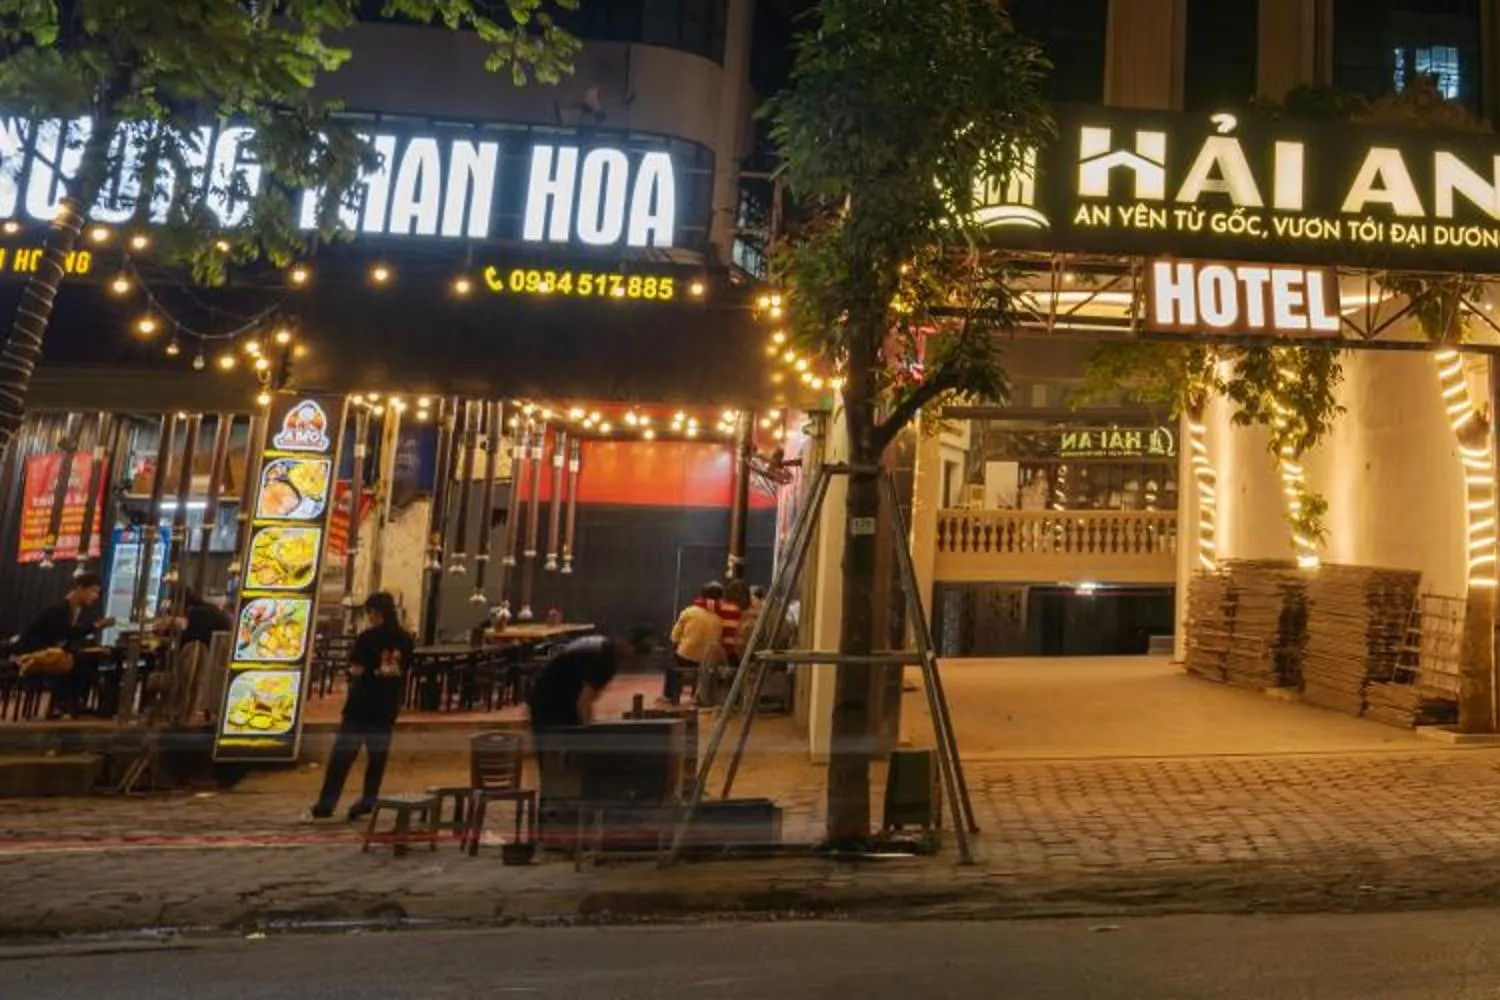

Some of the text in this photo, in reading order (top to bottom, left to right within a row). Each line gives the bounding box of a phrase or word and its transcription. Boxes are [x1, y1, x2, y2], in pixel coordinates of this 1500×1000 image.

[523, 144, 676, 248] HOA
[1078, 113, 1304, 211] HẢI
[1074, 204, 1111, 226] AN
[1118, 203, 1167, 229] YÊN
[1174, 207, 1207, 231] TỪ
[1273, 216, 1341, 240] VƯƠN
[1348, 215, 1384, 242] TỚI
[1389, 223, 1427, 248] ĐẠI
[1153, 260, 1341, 332] HOTEL
